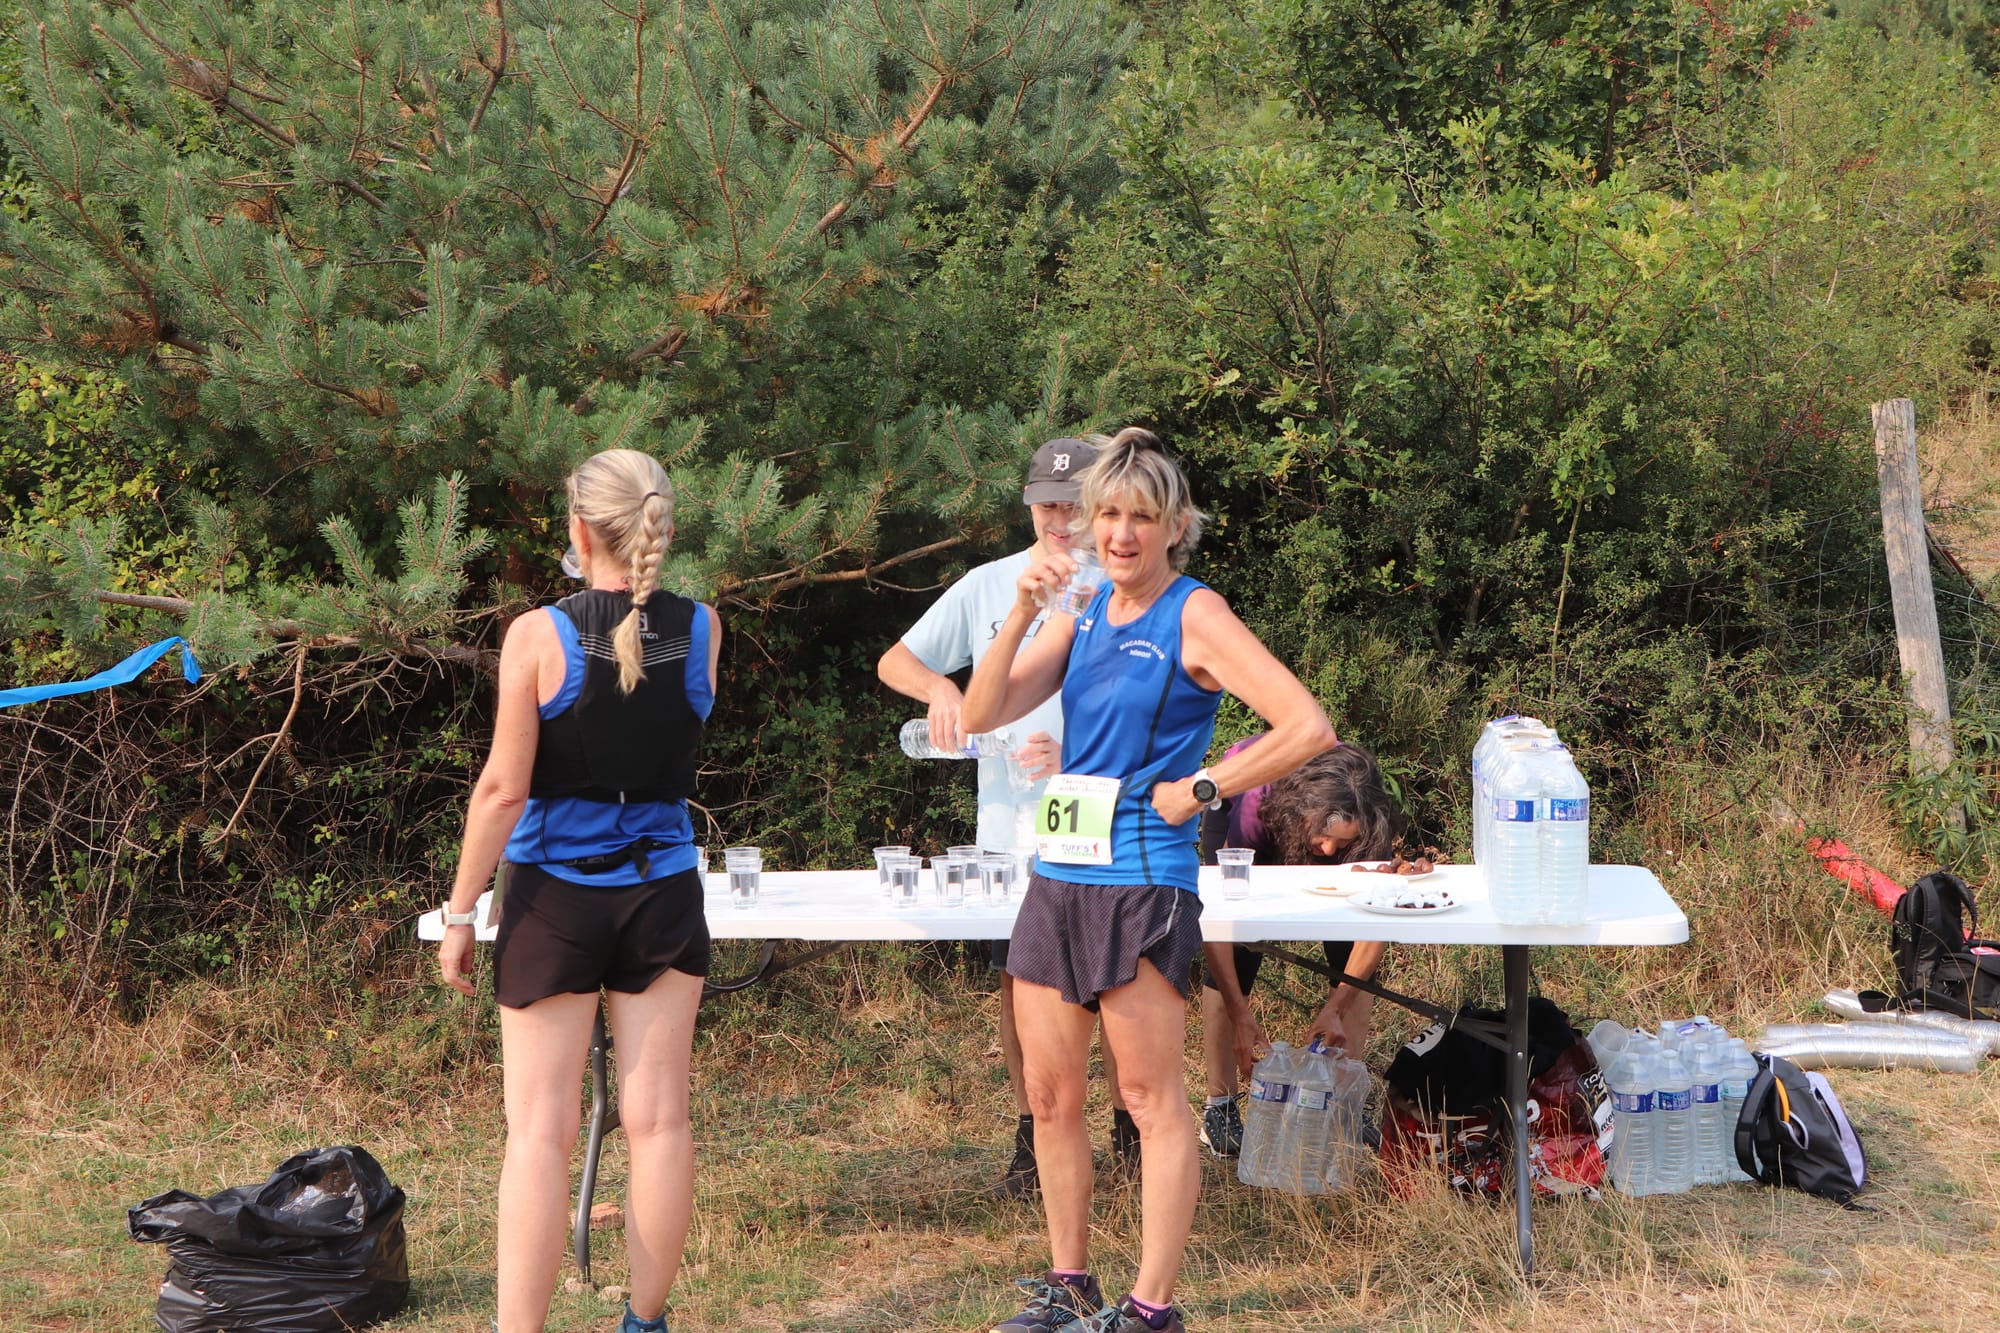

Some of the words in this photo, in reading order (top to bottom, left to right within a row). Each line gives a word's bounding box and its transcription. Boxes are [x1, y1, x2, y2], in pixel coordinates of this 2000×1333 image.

[1051, 453, 1071, 475] D
[1119, 639, 1152, 651] MACADAM
[1151, 644, 1166, 660] CLUB
[1047, 798, 1080, 833] 61
